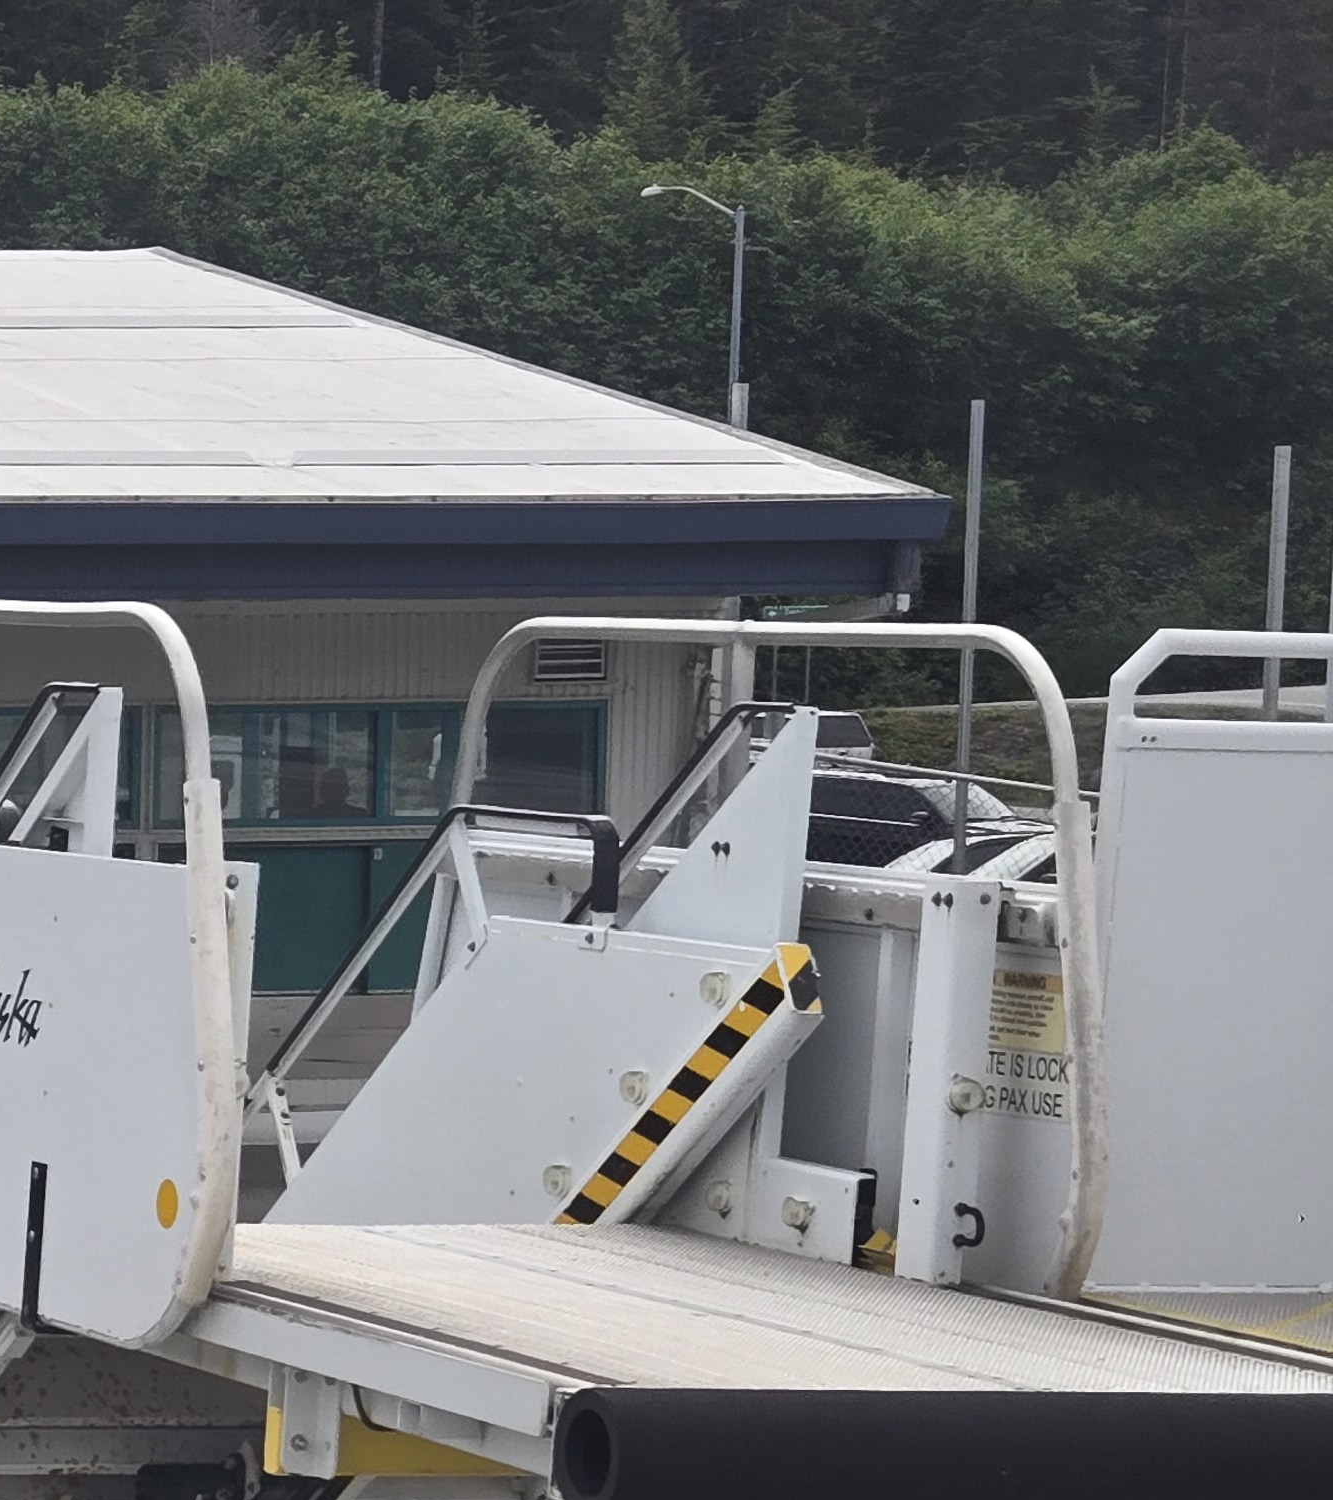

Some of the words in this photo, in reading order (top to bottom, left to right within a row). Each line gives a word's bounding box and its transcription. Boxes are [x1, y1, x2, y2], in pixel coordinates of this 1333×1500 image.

[986, 1051, 1006, 1076] TE
[1010, 1053, 1024, 1078] IS
[999, 1086, 1028, 1113] PAX
[1032, 1091, 1062, 1117] USE
